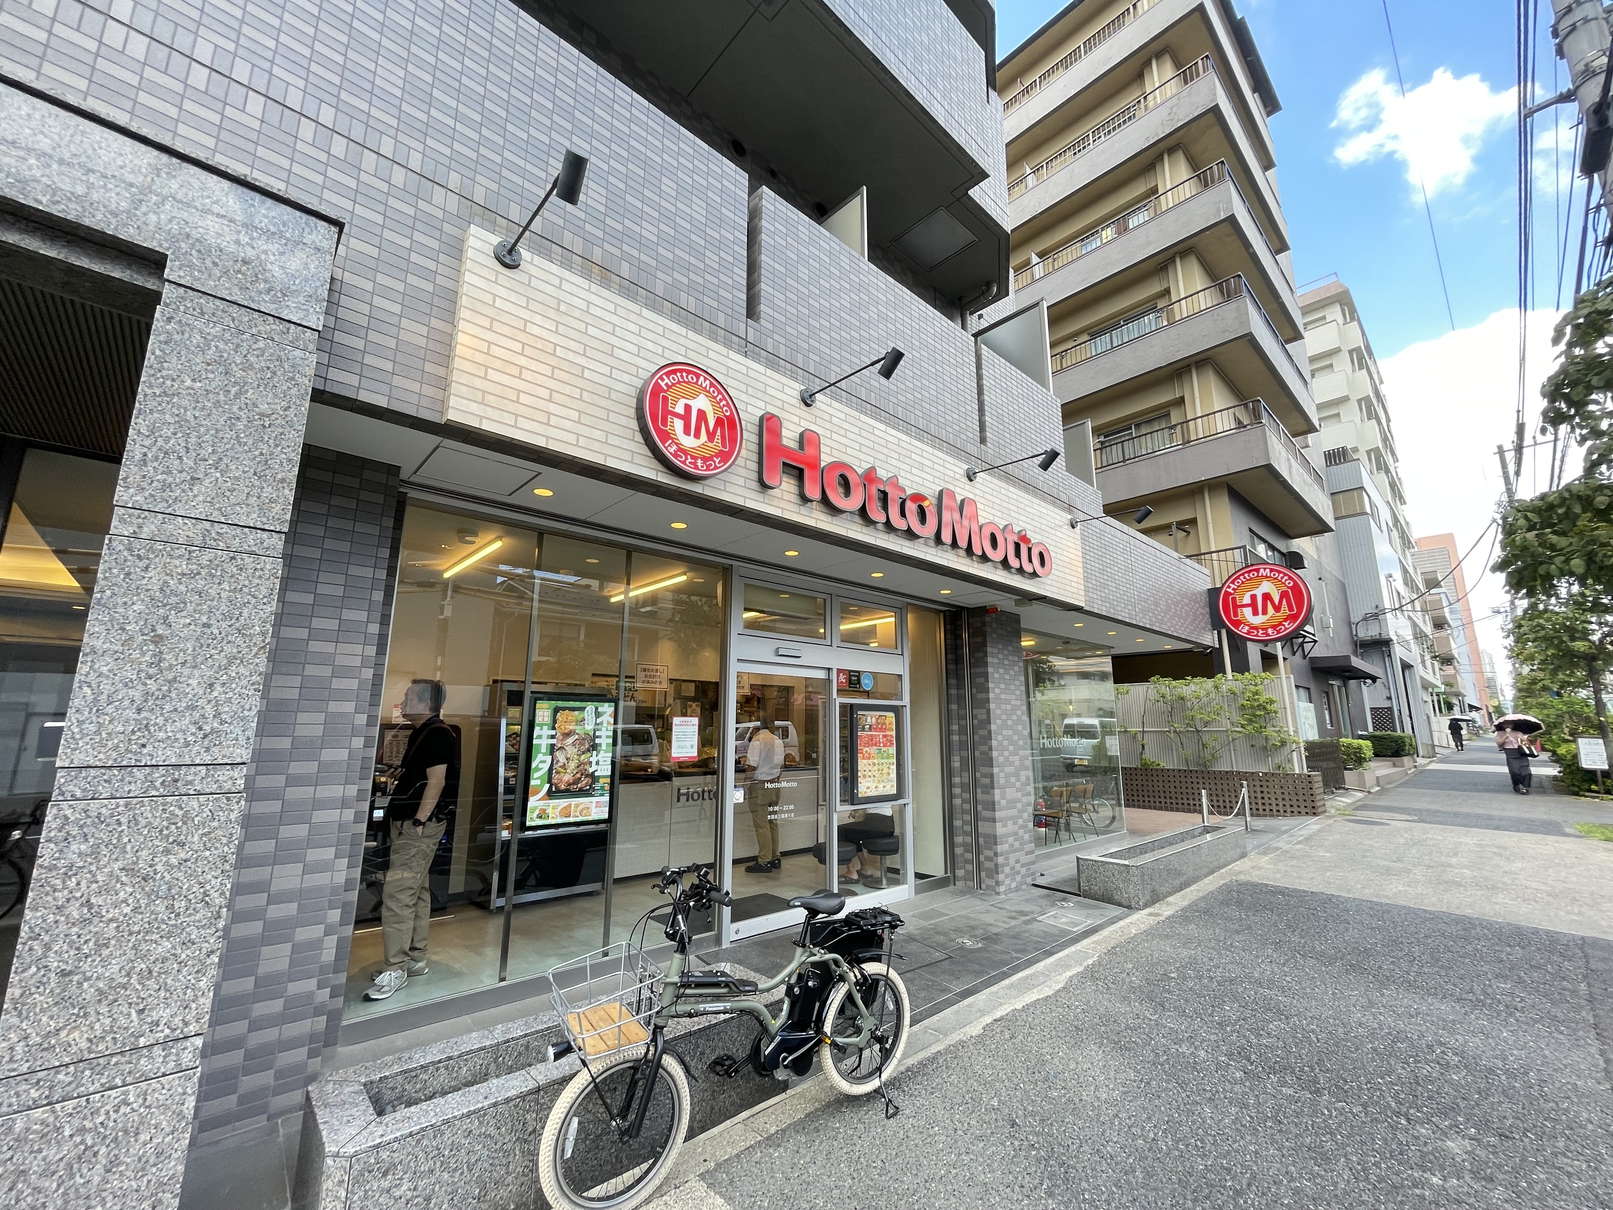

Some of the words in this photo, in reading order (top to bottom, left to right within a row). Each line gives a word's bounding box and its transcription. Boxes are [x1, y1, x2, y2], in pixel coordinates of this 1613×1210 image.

[660, 393, 728, 451] HM
[665, 440, 724, 470] ほっともっと
[1231, 589, 1296, 619] HM
[1239, 620, 1293, 636] ほっともっと
[529, 725, 556, 801] 牛タン
